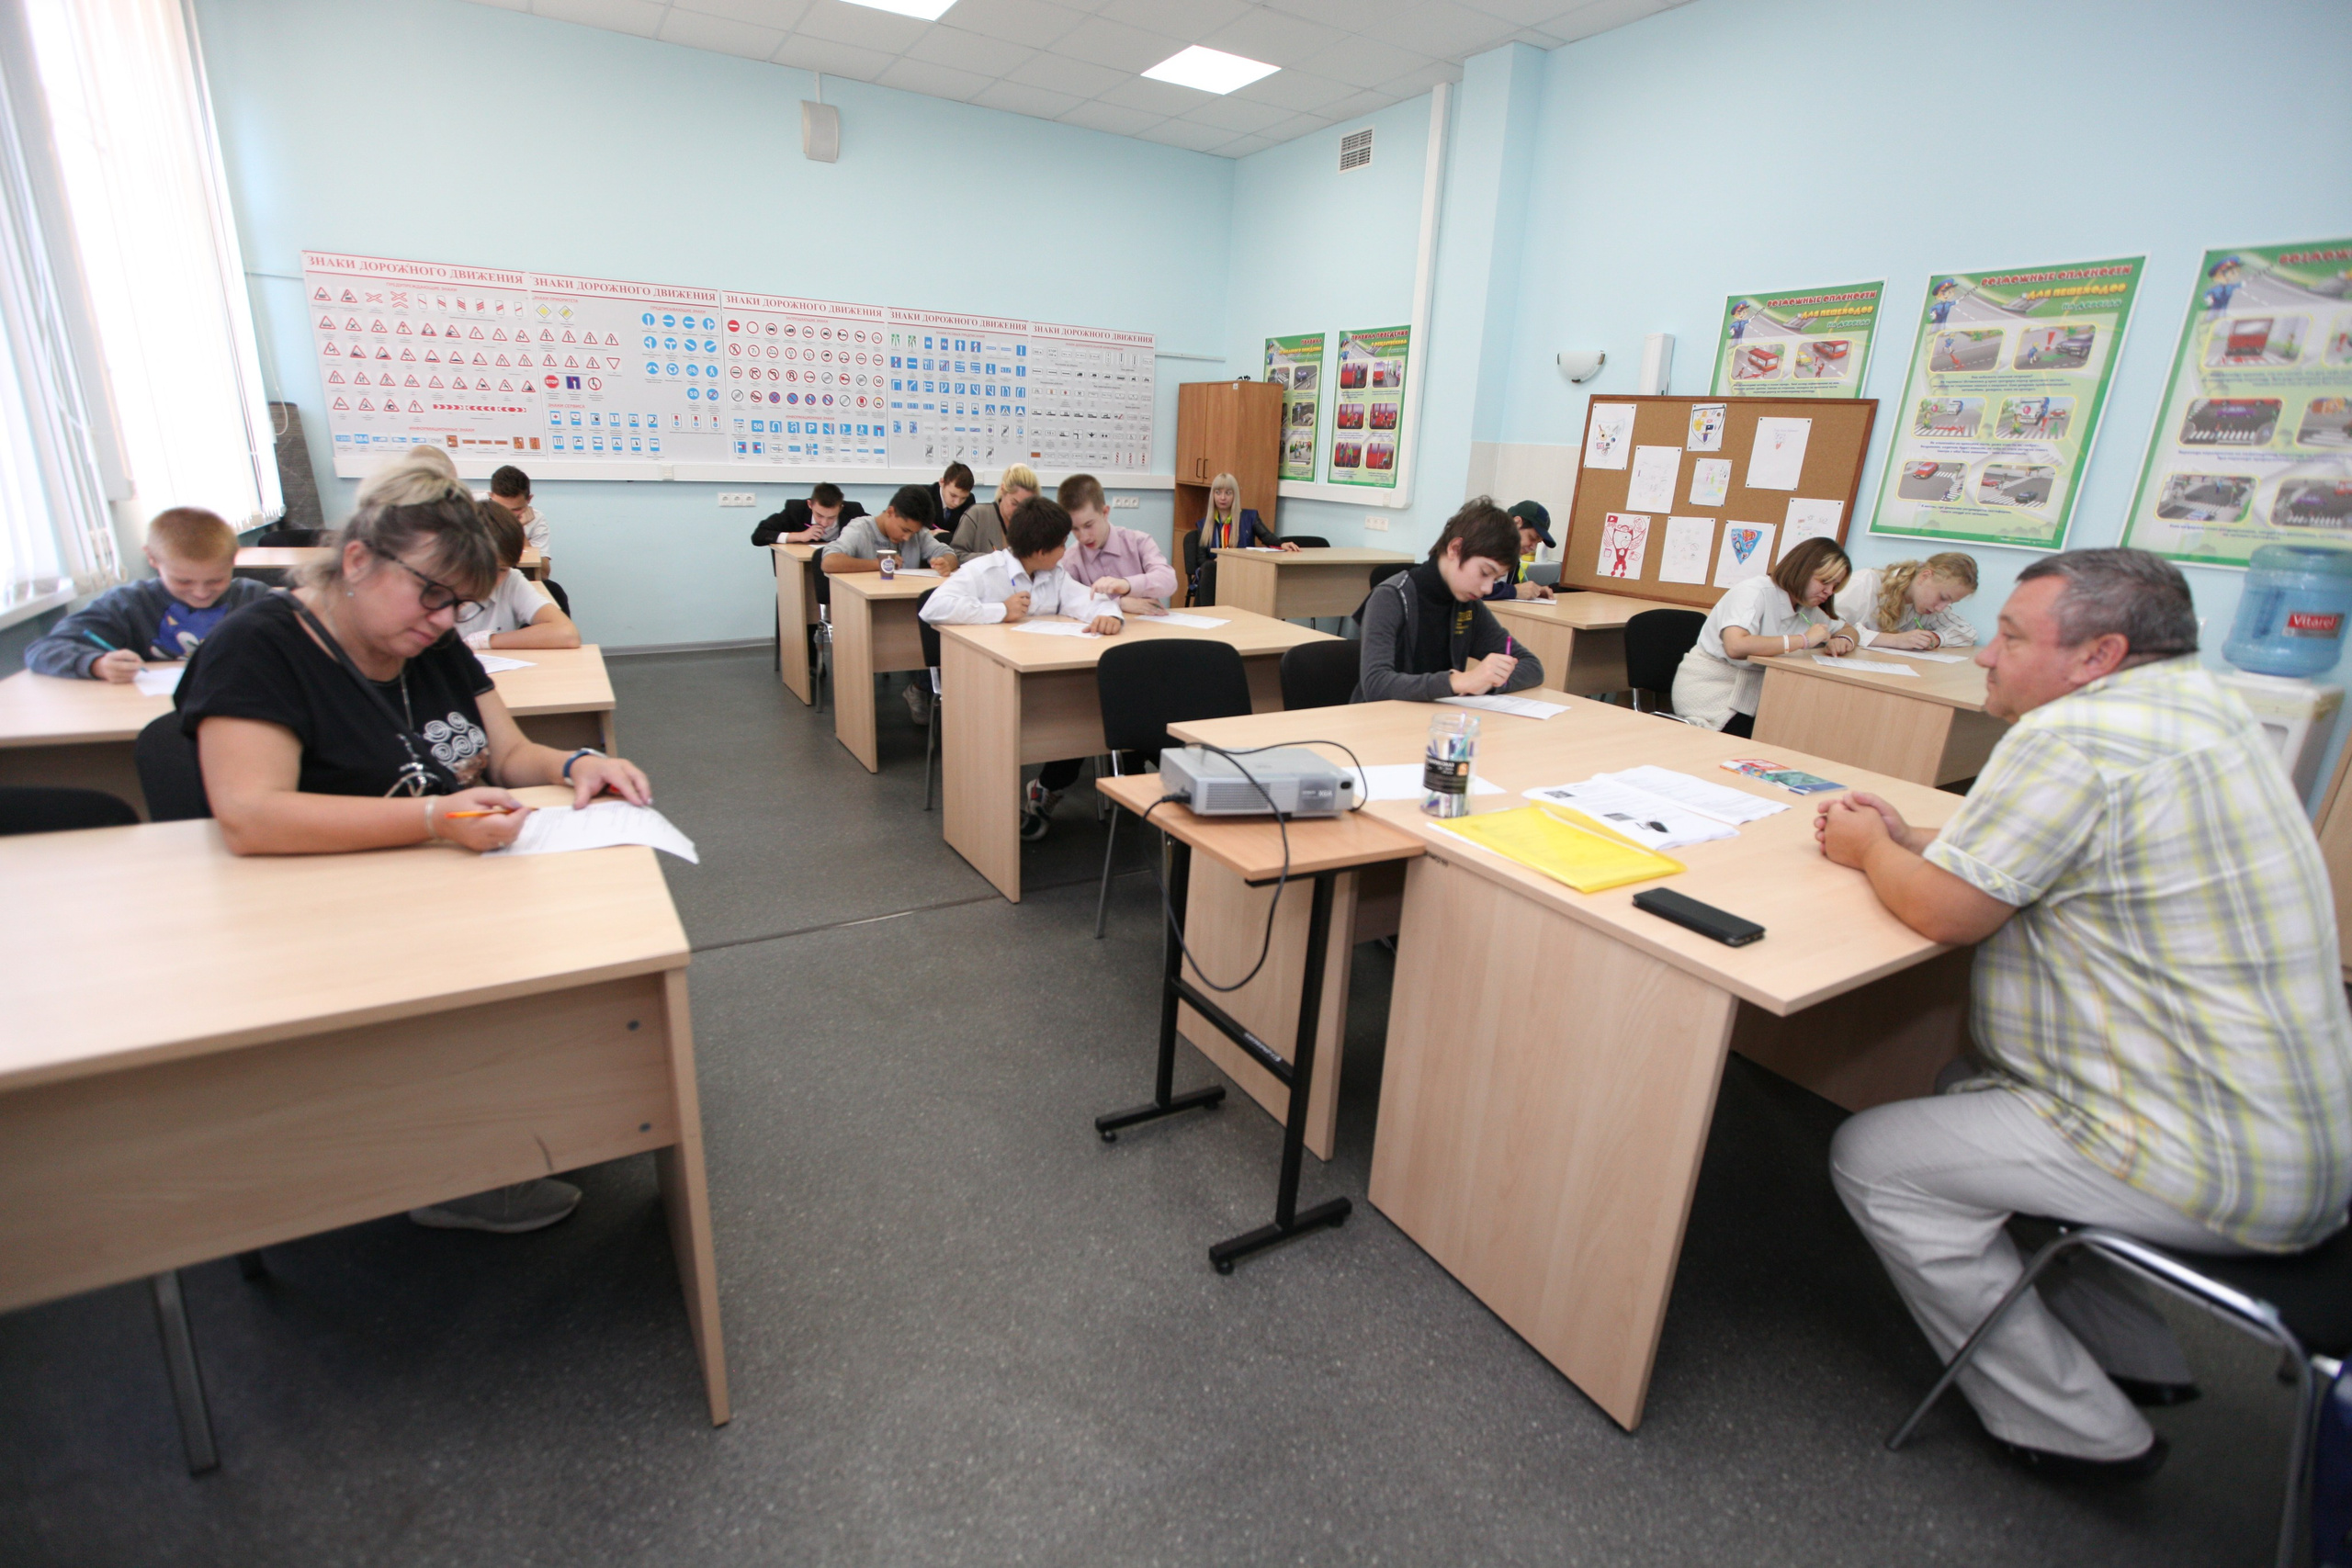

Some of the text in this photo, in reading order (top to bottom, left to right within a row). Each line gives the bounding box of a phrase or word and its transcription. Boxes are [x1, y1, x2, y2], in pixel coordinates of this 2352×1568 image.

[2279, 248, 2352, 265] ВОЗМОЖ
[308, 255, 524, 285] ЗНАКИ ДОРОЖНОГО ДВИЖЕНИЯ
[1981, 265, 2132, 287] ВОЗМОЖНЫЕ ОПАСНОСТИ
[534, 276, 716, 302] ЗНАКИ ДОРОЖНОГО ДВИЖЕНИЯ
[2026, 283, 2127, 300] ДЛЯ ПЕШЕХОДОВ
[725, 294, 882, 317] ЗНАКИ ДОРОЖНОГО ДВИЖЕНИЯ
[1767, 290, 1877, 308] ВОЗМОЖНЫЕ ОПАСНОСТИ
[890, 310, 1027, 331] ЗНАКИ ДОРОЖНОГО ДВИЖЕНИЯ
[1801, 306, 1873, 320] ДЛЯ ПЕШЕХОДОВ
[1034, 325, 1153, 344] ЗНАКИ ДОРОЖНОГО ДВИЖЕНИЯ
[2294, 615, 2335, 627] Vitarel
